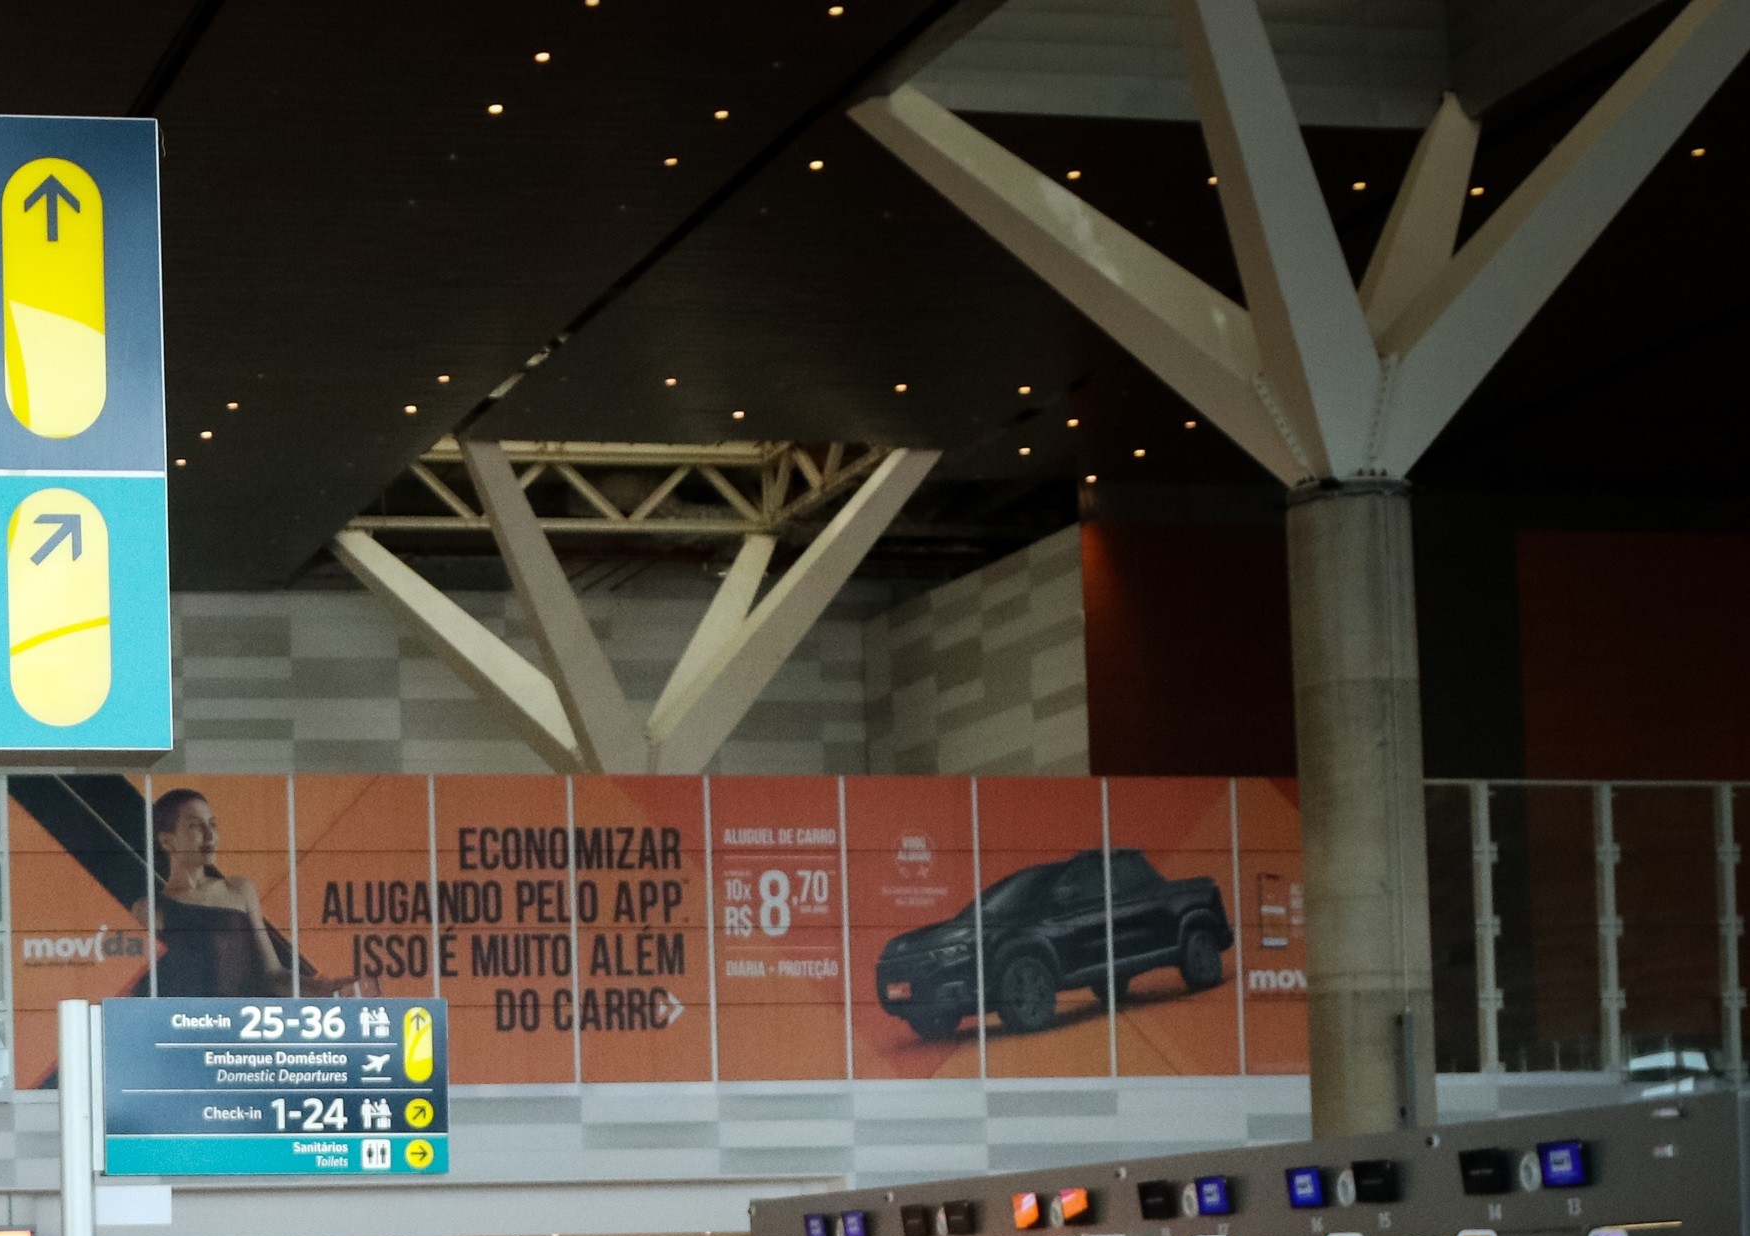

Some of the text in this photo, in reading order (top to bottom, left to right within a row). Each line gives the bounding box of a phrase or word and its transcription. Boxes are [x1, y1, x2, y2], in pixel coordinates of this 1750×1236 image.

[458, 826, 683, 871] ECONOMIZAR
[778, 828, 794, 844] DE
[797, 827, 837, 844] CARRO
[321, 879, 503, 925] ALUGANDO
[515, 879, 599, 924] PELO
[724, 905, 753, 937] R$
[23, 924, 144, 963] movida
[353, 926, 685, 978] ISSO É MUITO ALÉM
[171, 1005, 346, 1039] Check-in 25-36
[495, 987, 540, 1032] DO
[204, 1051, 348, 1068] Embarque Doméstico
[216, 1070, 348, 1085] Domestic Departures
[203, 1098, 348, 1131] Check-in 1-24
[292, 1141, 349, 1154] Sanitários
[315, 1155, 349, 1168] Toilets
